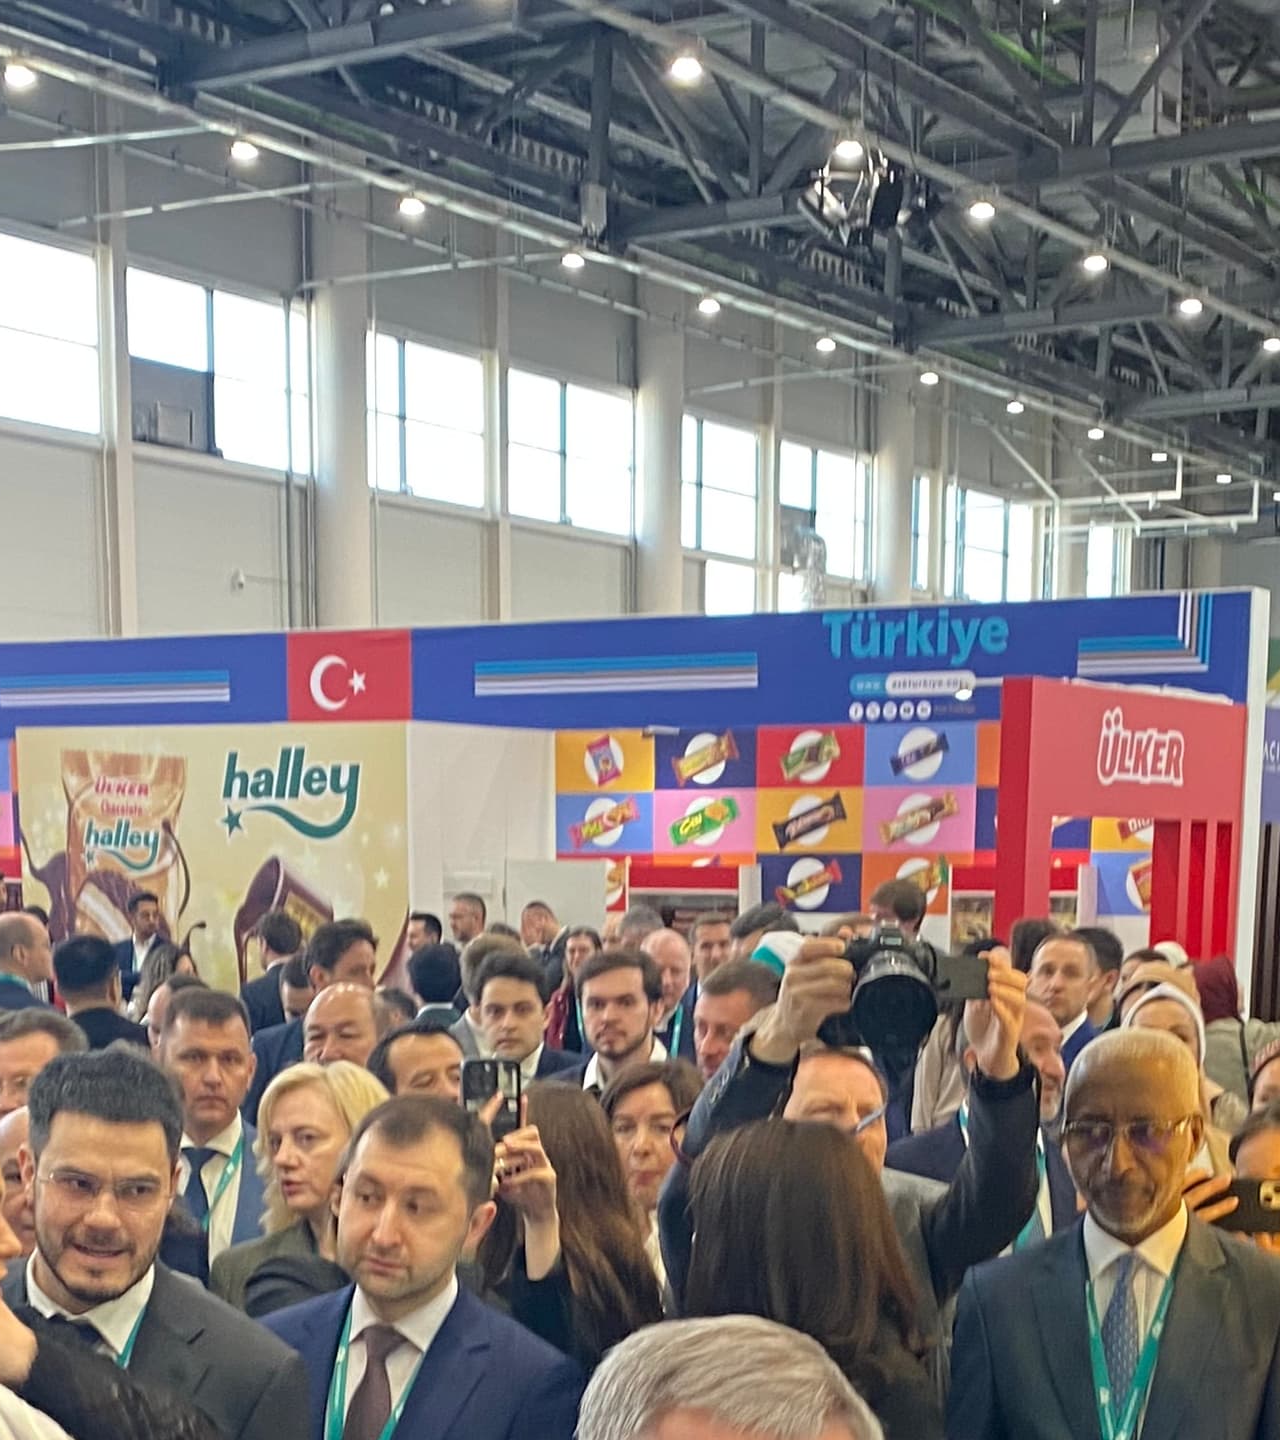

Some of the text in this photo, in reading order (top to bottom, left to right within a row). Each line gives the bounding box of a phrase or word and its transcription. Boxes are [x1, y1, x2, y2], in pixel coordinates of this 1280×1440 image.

[822, 607, 1009, 667] Türkiye
[1097, 706, 1185, 787] ÜLKER
[220, 745, 361, 840] halley
[82, 816, 161, 871] halley
